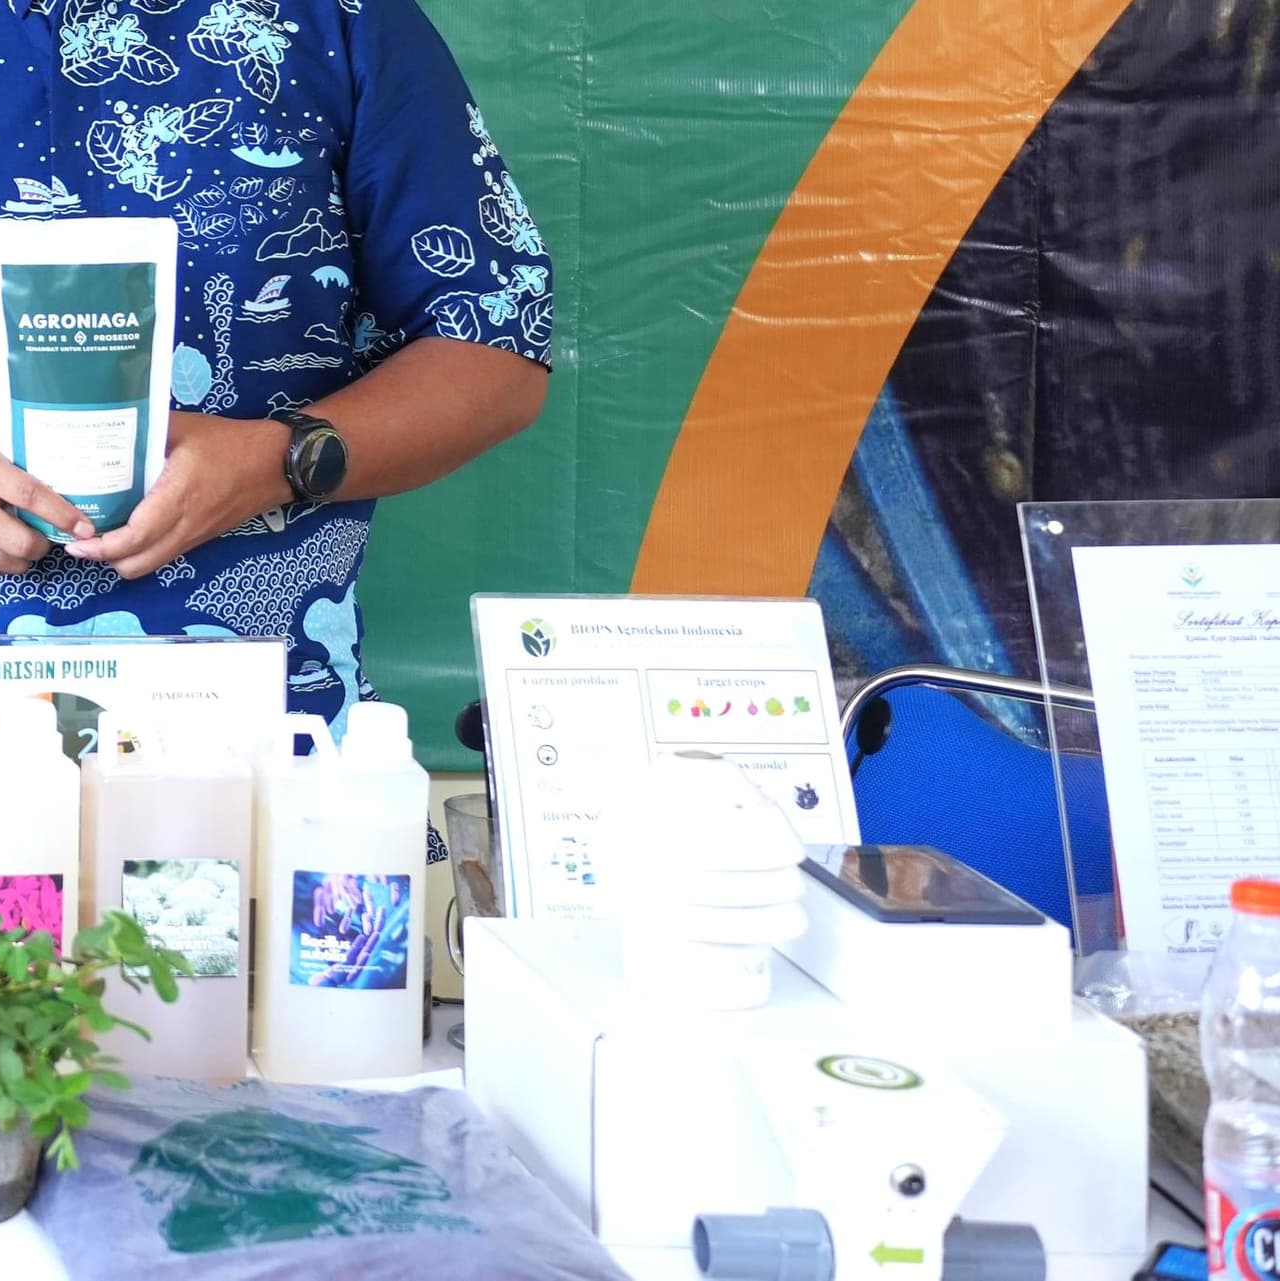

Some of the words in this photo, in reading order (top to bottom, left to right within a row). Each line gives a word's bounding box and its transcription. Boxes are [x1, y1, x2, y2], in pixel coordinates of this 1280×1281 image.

[18, 312, 140, 330] AGRONIAGA
[92, 332, 141, 342] PROSESOR
[616, 624, 680, 638] Agrotekno
[682, 624, 743, 637] Indonesia
[61, 659, 118, 679] PUPUK
[569, 675, 619, 688] problem
[696, 676, 733, 689] Target
[752, 760, 788, 772] model
